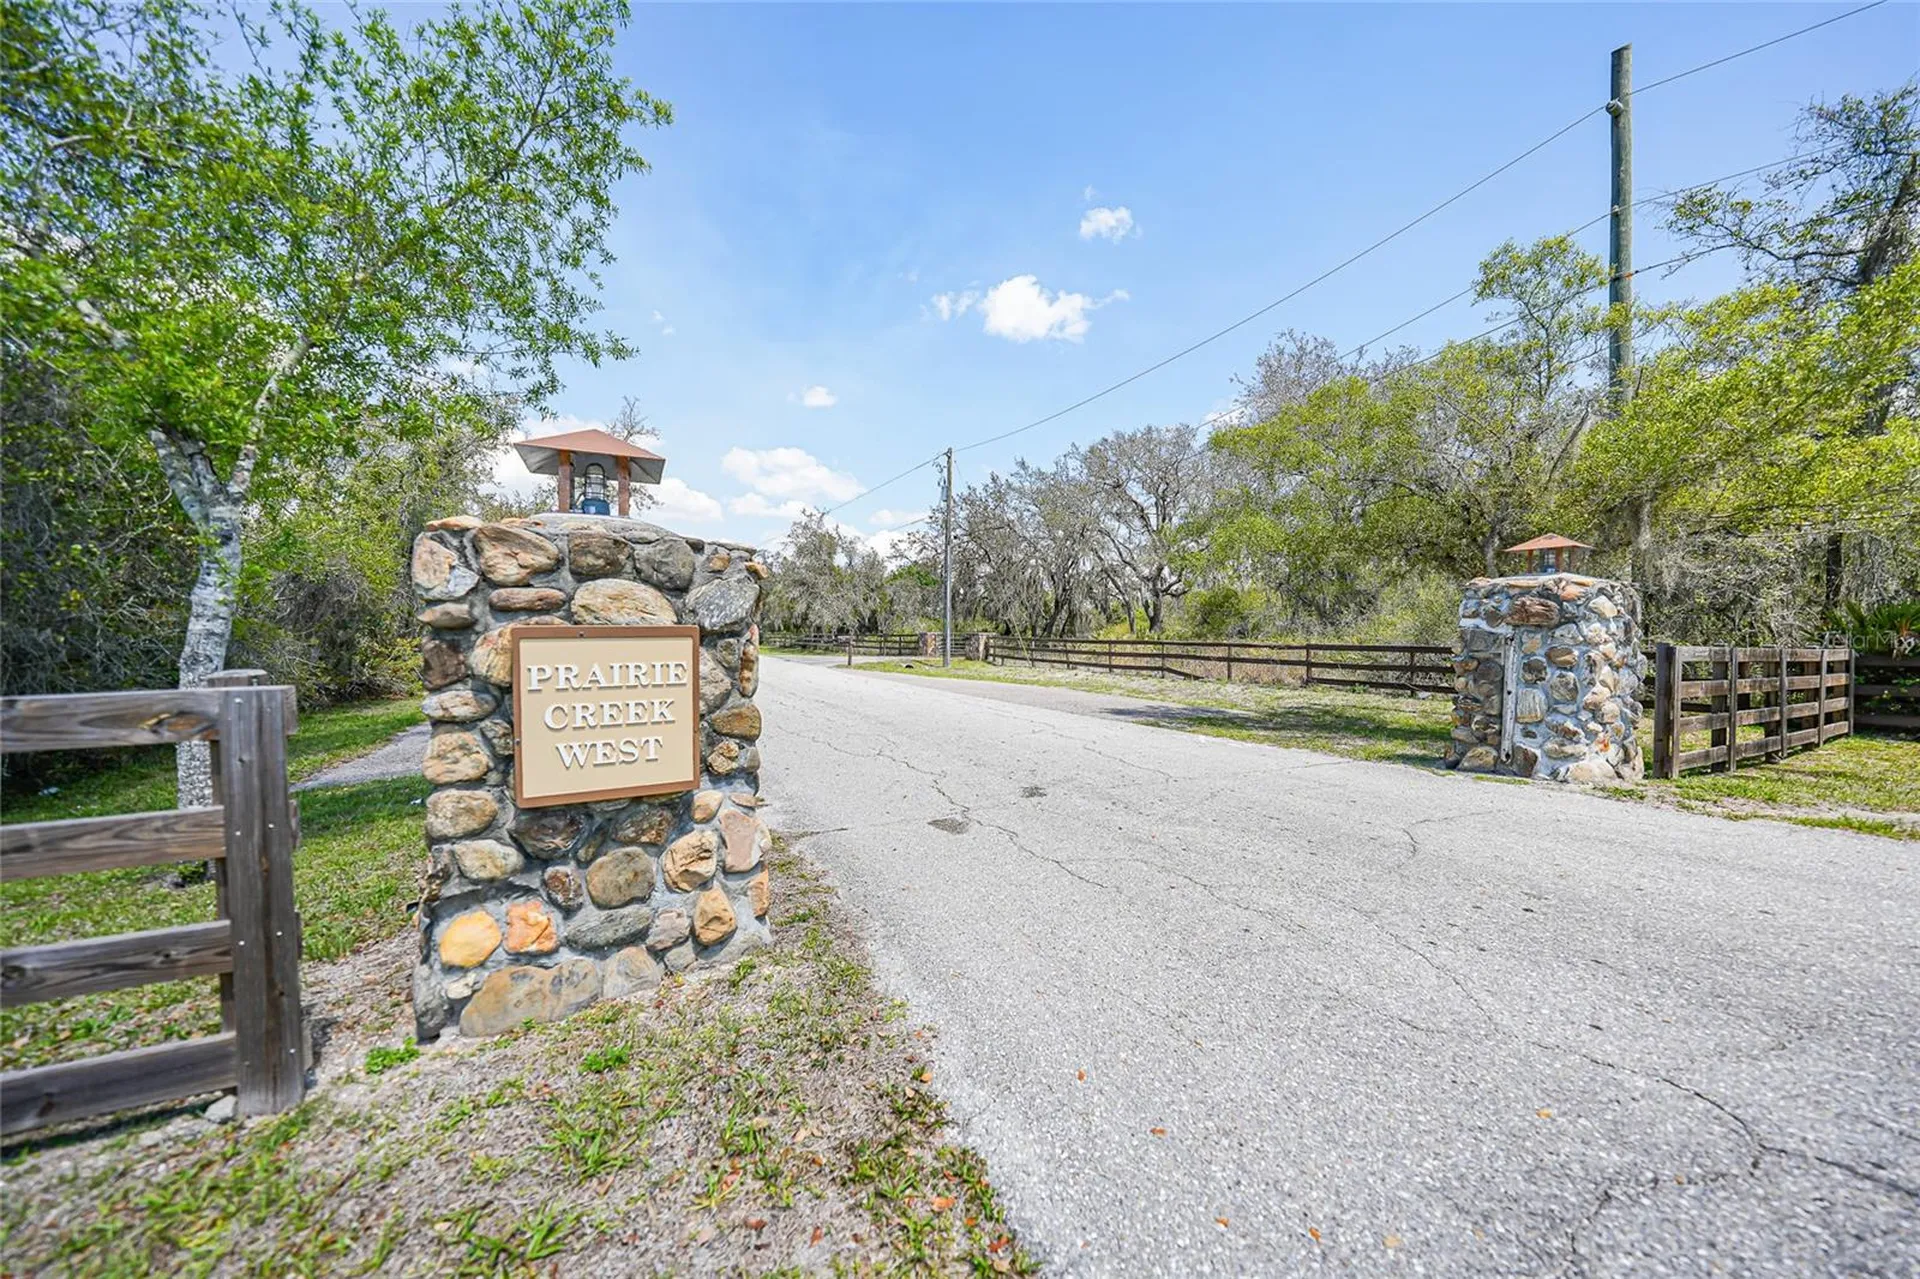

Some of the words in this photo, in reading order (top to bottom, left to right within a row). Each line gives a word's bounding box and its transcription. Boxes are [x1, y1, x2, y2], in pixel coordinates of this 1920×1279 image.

[526, 661, 688, 692] PRAIRIE
[543, 698, 676, 732] CREEK
[555, 735, 664, 770] WEST
